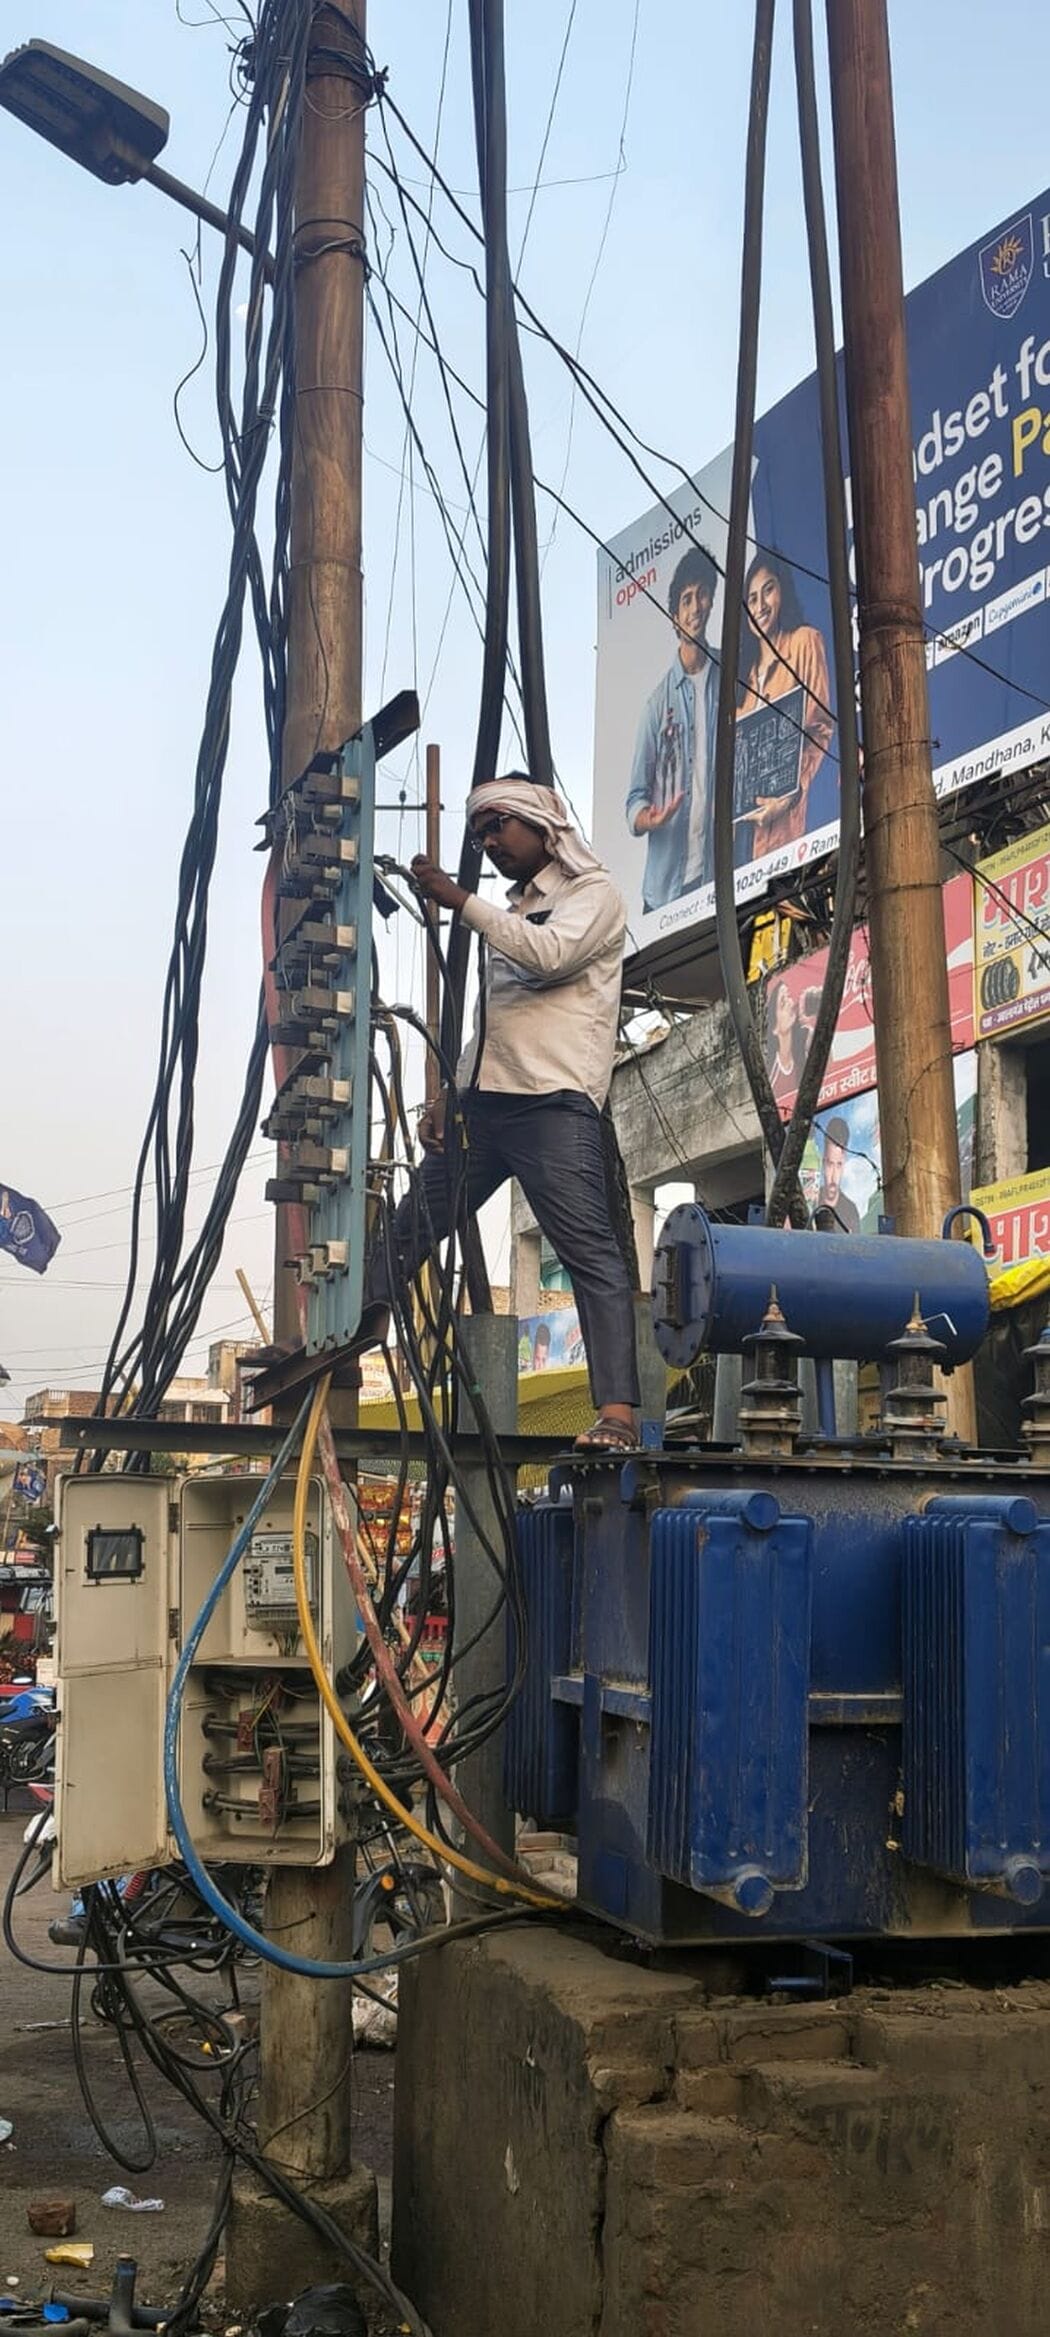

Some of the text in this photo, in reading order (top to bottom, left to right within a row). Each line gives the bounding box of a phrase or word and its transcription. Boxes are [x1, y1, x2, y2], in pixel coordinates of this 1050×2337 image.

[991, 264, 1028, 300] RAMA
[615, 507, 702, 583] admissions
[616, 567, 657, 606] open
[736, 855, 788, 893] 1020-449
[810, 833, 841, 857] Ram
[951, 738, 1036, 786] Mandhana,
